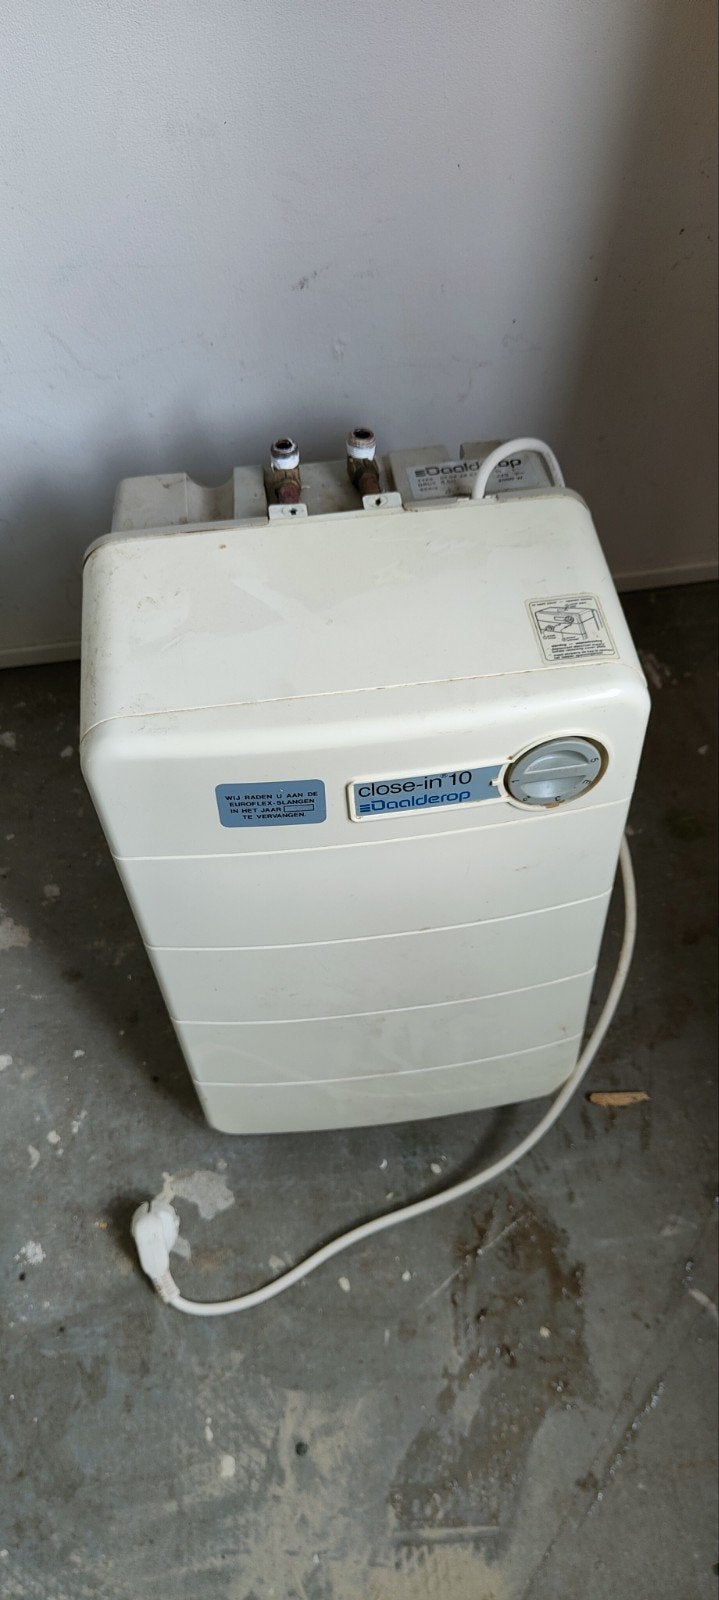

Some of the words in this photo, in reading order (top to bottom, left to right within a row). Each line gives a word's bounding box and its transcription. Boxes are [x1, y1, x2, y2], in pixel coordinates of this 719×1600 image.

[425, 459, 522, 476] Daaldop
[449, 770, 472, 786] 10
[229, 798, 315, 807] EUROFLEX-SLANGEN
[371, 790, 471, 811] Daalderop
